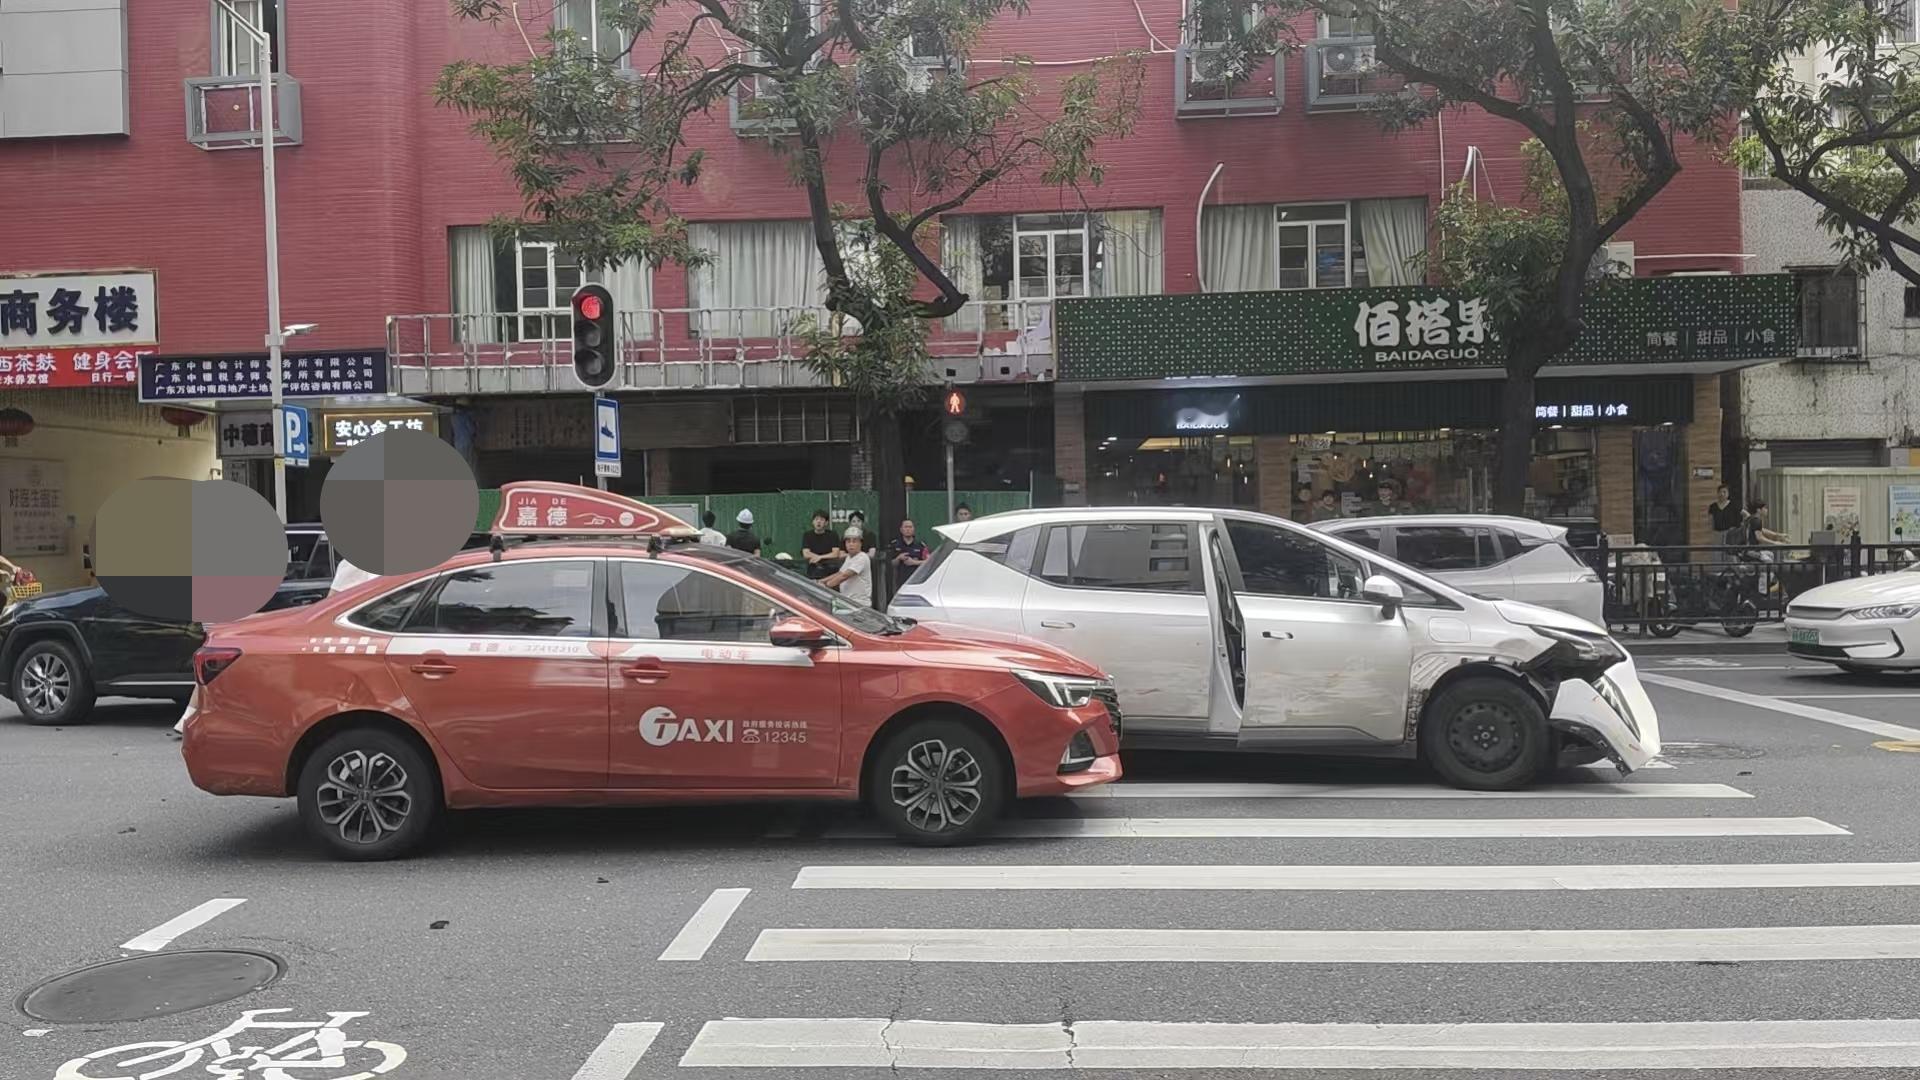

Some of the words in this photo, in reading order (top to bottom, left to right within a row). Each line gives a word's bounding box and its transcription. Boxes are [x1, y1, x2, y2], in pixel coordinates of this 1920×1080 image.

[0, 286, 138, 336] 商务楼
[1646, 331, 1678, 346] 简餐
[1696, 329, 1728, 345] 甜品
[1744, 328, 1776, 343] 小食
[1375, 348, 1478, 362] BAIDAGUO
[1536, 406, 1558, 418] 简餐
[1571, 405, 1594, 416] 甜品
[1605, 404, 1628, 416] 小食
[285, 411, 300, 453] P
[517, 506, 567, 526] 嘉德
[639, 706, 734, 746] TAXI
[765, 732, 807, 743] 12345
